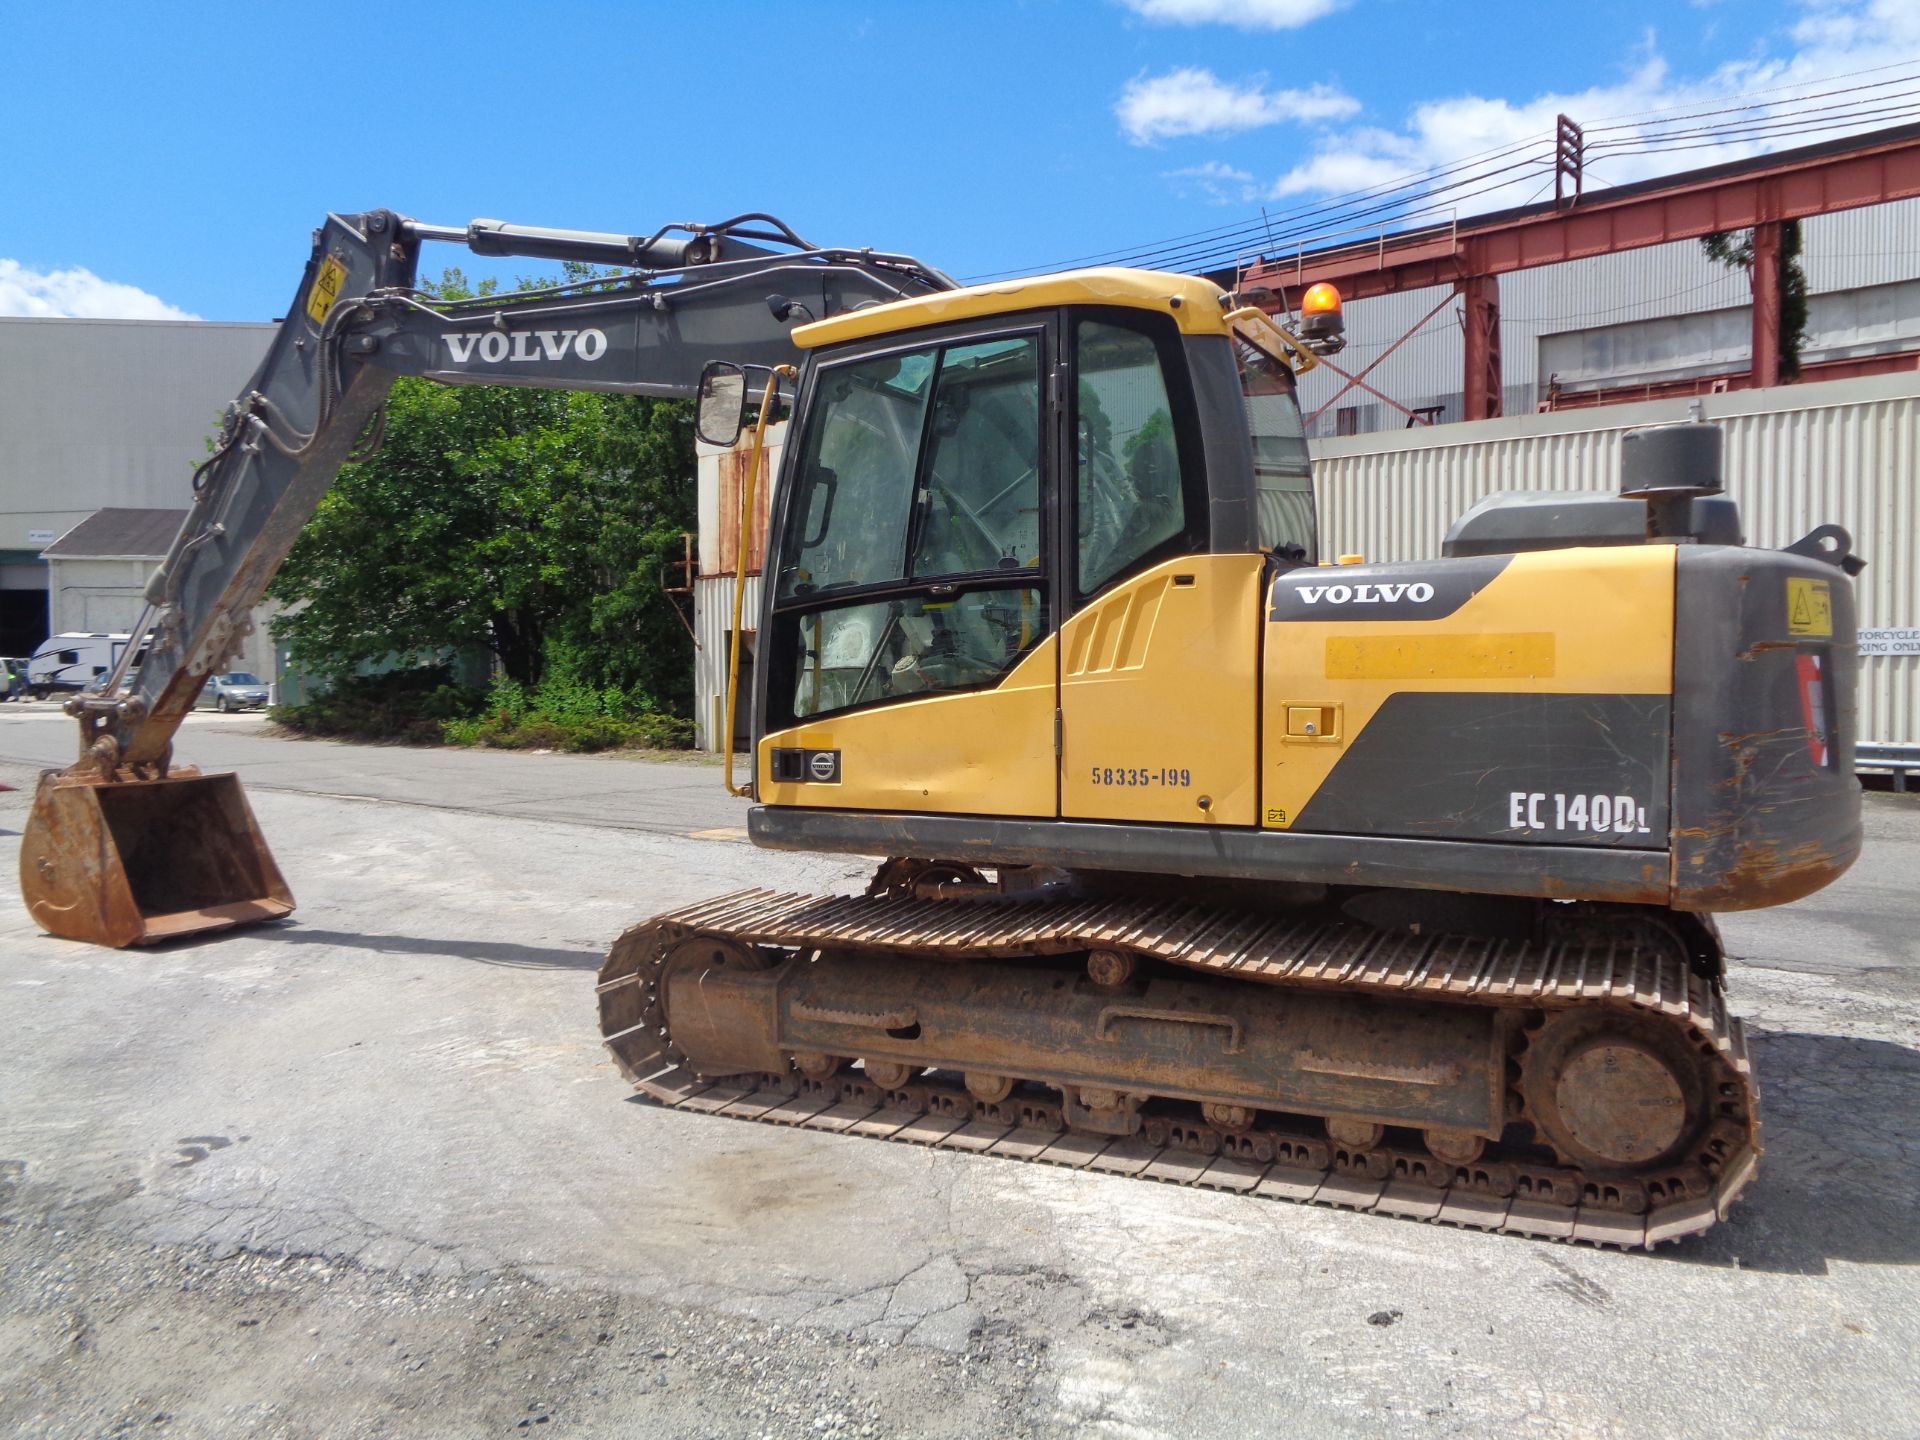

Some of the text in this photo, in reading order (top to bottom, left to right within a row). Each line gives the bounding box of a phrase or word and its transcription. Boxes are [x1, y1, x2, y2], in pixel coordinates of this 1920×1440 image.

[441, 328, 608, 363] VOLVO
[1295, 582, 1435, 604] VOLVO
[1091, 767, 1191, 787] 58335-199
